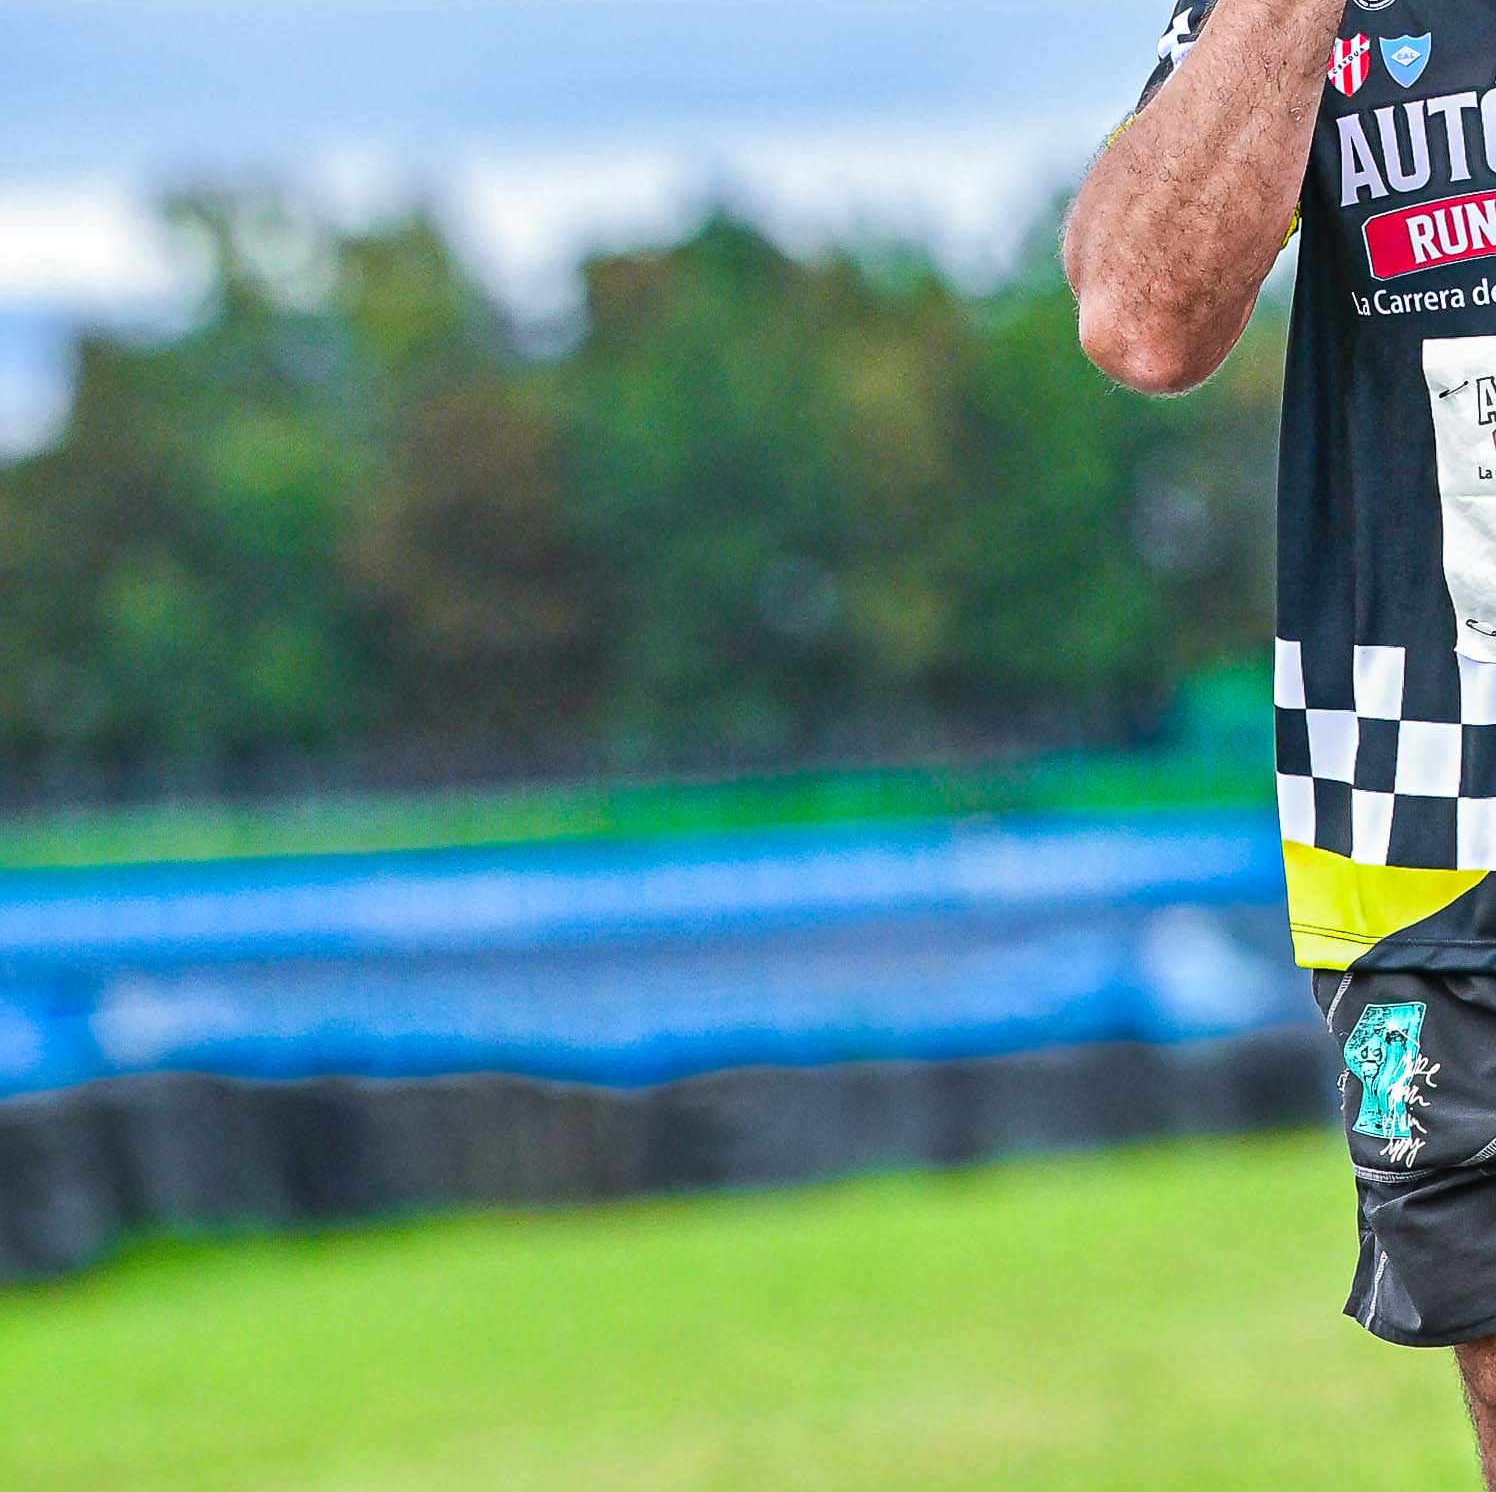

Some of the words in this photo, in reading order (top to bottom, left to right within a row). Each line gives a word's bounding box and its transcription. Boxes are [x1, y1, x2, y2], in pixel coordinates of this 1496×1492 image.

[1352, 291, 1371, 316] La
[1373, 289, 1466, 315] Carrera
[1478, 466, 1492, 480] La
